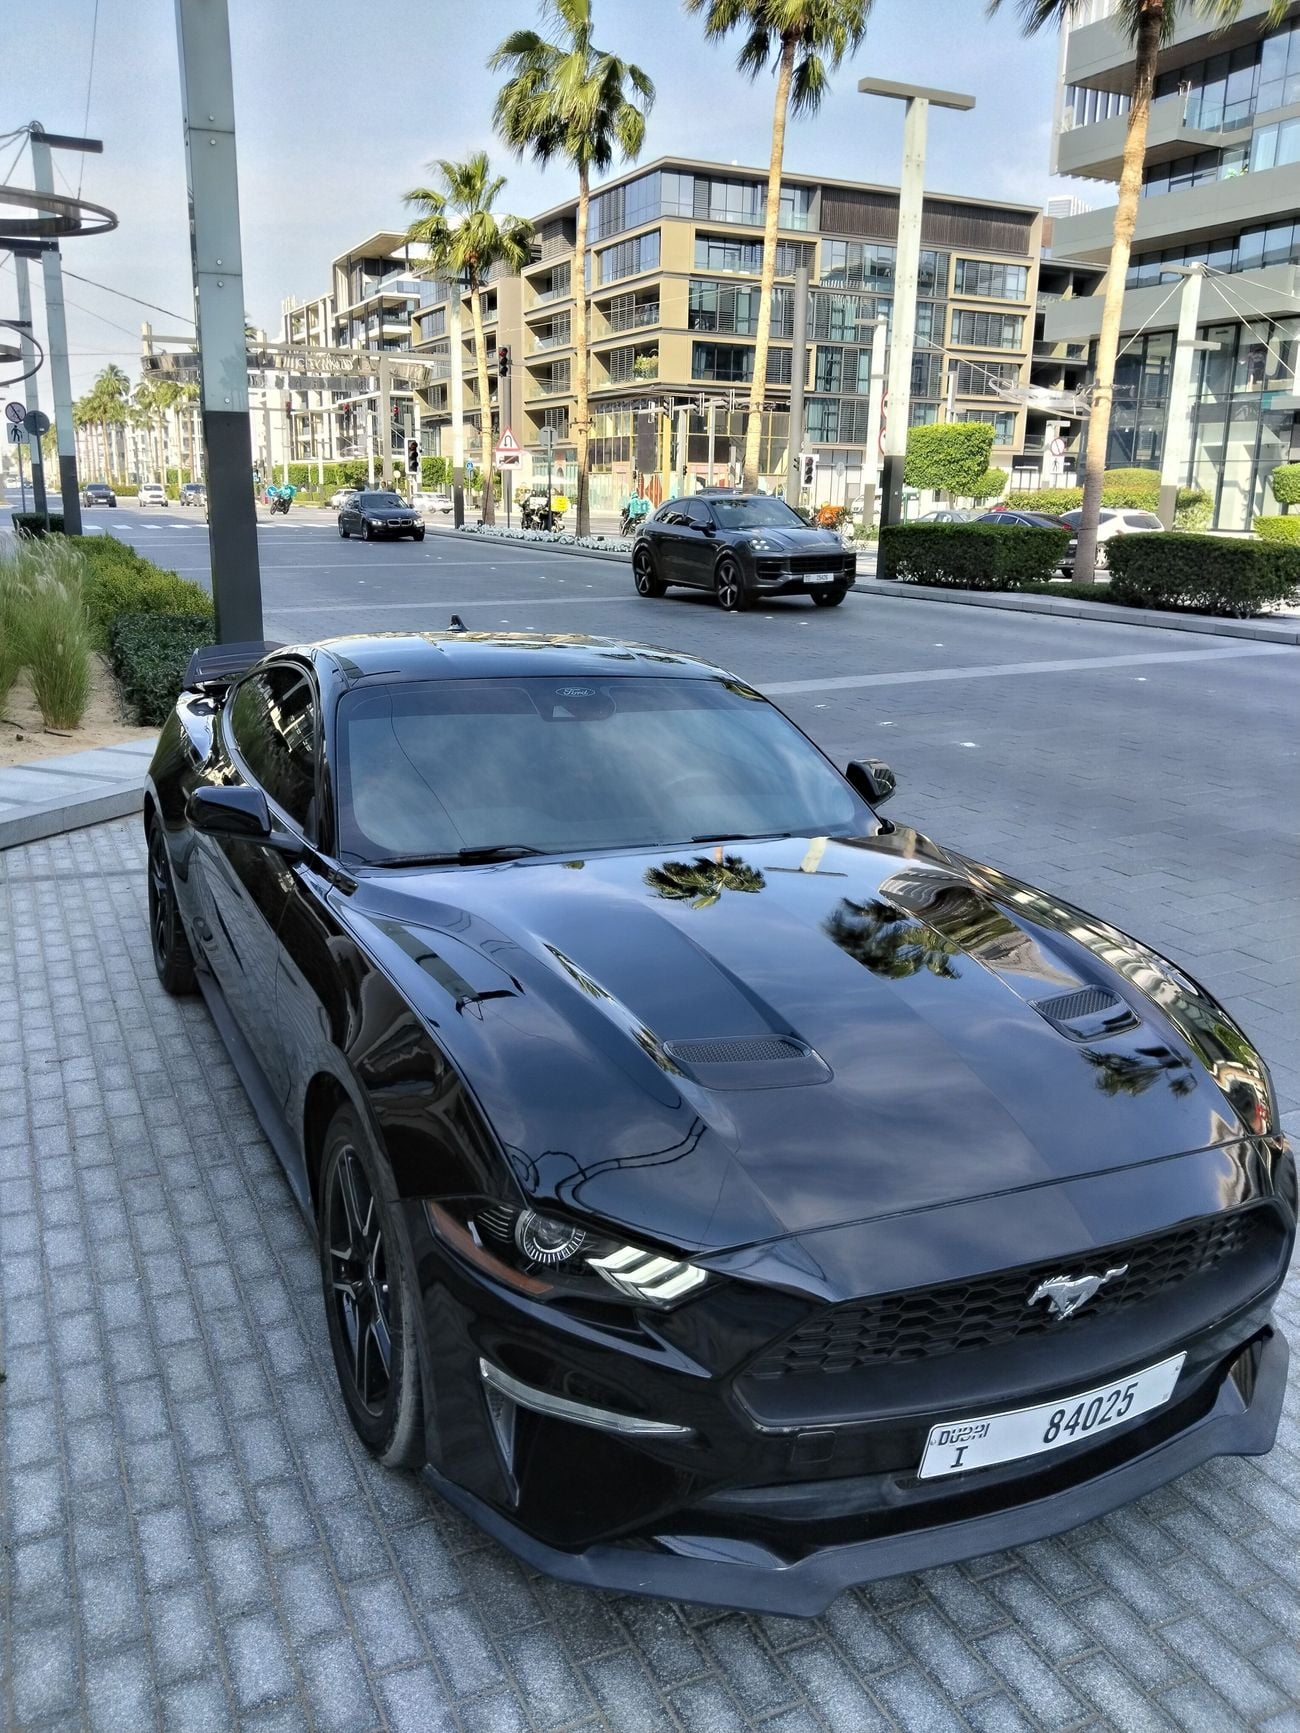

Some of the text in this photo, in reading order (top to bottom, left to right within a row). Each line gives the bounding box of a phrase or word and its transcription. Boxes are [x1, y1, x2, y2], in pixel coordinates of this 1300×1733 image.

[563, 687, 590, 697] Ford
[1043, 1382, 1139, 1444] 84025
[950, 1446, 969, 1468] I
